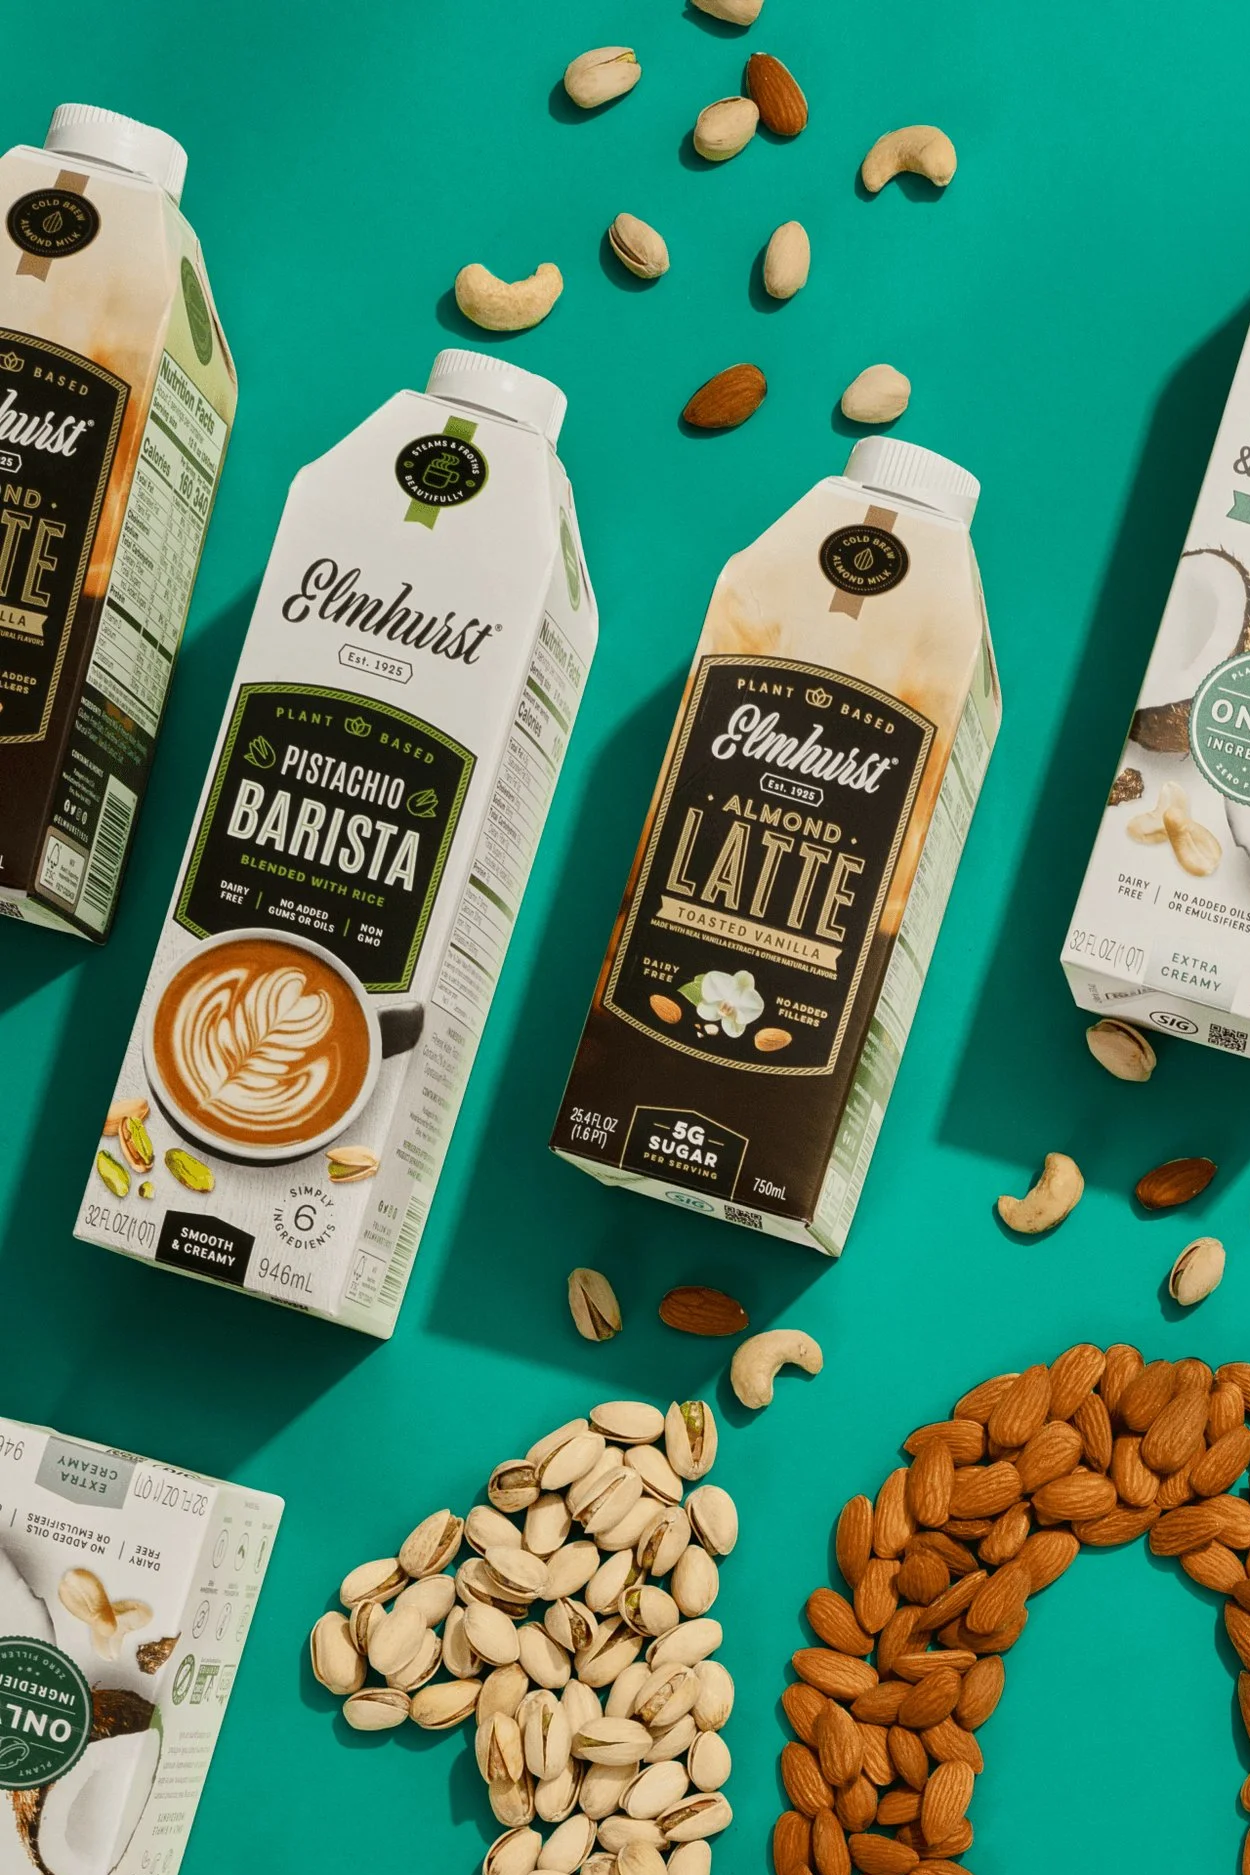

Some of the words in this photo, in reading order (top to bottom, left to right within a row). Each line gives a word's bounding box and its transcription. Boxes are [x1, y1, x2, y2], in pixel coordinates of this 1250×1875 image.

[31, 199, 60, 210] COLD
[62, 201, 86, 221] BREW
[20, 218, 52, 247] ALMOND
[56, 231, 81, 247] MILK
[33, 367, 89, 396] BASED
[410, 440, 447, 456] STEAMS
[456, 444, 479, 474] FROTHS
[405, 475, 465, 502] BEAUTIFULLY
[842, 535, 870, 546] COLD
[872, 538, 895, 559] BREW
[832, 554, 864, 585] ALMOND
[868, 569, 892, 585] MILK
[346, 651, 370, 667] Est.
[374, 660, 404, 677] 1925
[280, 744, 405, 809] PISTACHIO
[722, 795, 842, 842] ALMOND
[227, 779, 420, 891] BARISTA
[240, 855, 306, 882] BLENDED
[309, 876, 347, 895] WITH
[351, 889, 385, 907] RICE
[666, 808, 865, 942] LATTE
[677, 908, 748, 937] TOASTED
[754, 930, 818, 960] VANILLA
[289, 1187, 333, 1208] SIMPLY
[274, 1209, 335, 1249] INGREDIENTS
[295, 1205, 317, 1231] 6
[56, 1456, 118, 1481] CREAMY
[61, 1471, 106, 1493] EXTRA
[26, 1523, 51, 1538] OILS
[27, 1512, 94, 1539] EMULSIFIERS
[96, 1533, 111, 1544] OR
[52, 1531, 88, 1549] ADDED
[90, 1543, 106, 1554] NO
[136, 1544, 160, 1559] FREE
[129, 1555, 161, 1571] DAIRY
